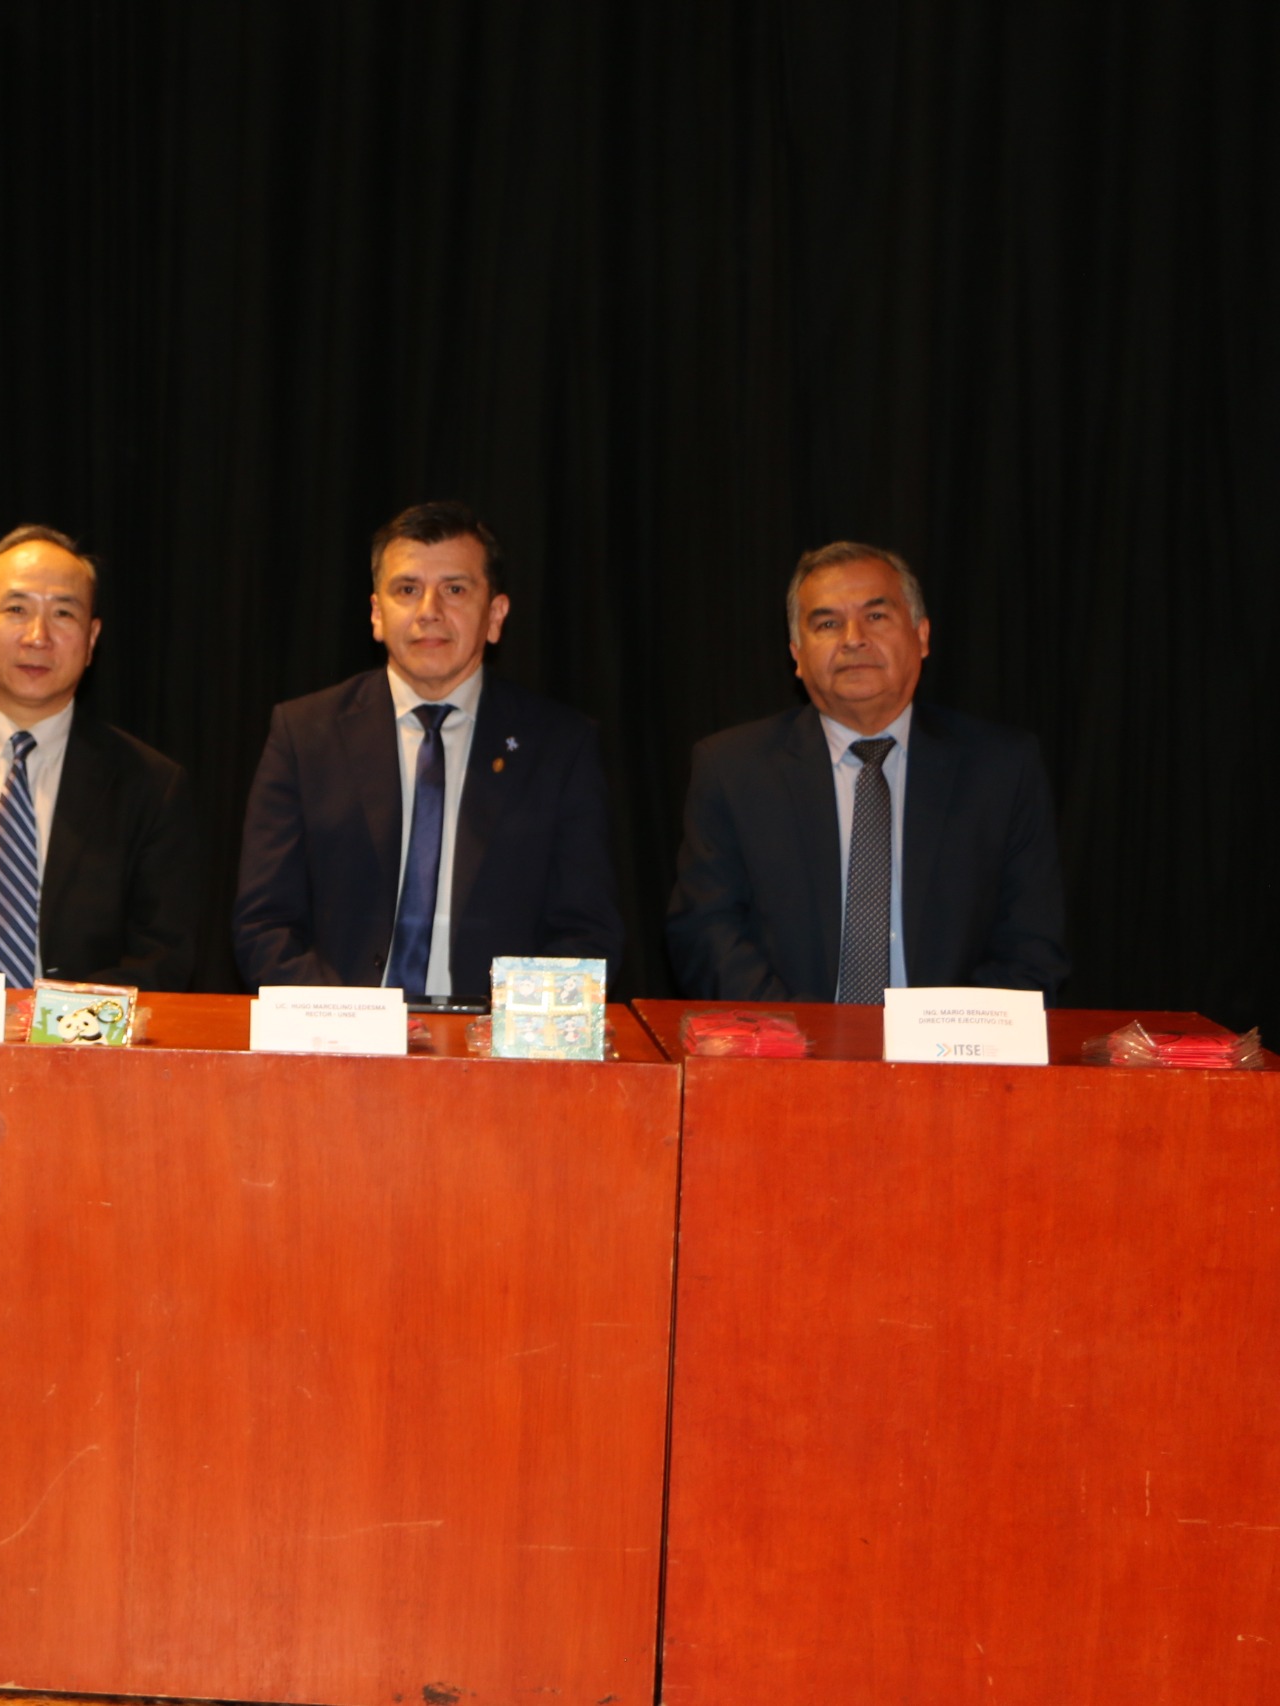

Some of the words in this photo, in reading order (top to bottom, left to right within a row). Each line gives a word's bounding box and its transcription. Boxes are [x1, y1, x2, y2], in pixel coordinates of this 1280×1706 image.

[966, 1009, 1008, 1018] BENAVENTE
[958, 1017, 997, 1025] EJECUTIVO
[998, 1018, 1014, 1026] ITSE
[953, 1044, 982, 1056] ITSE
